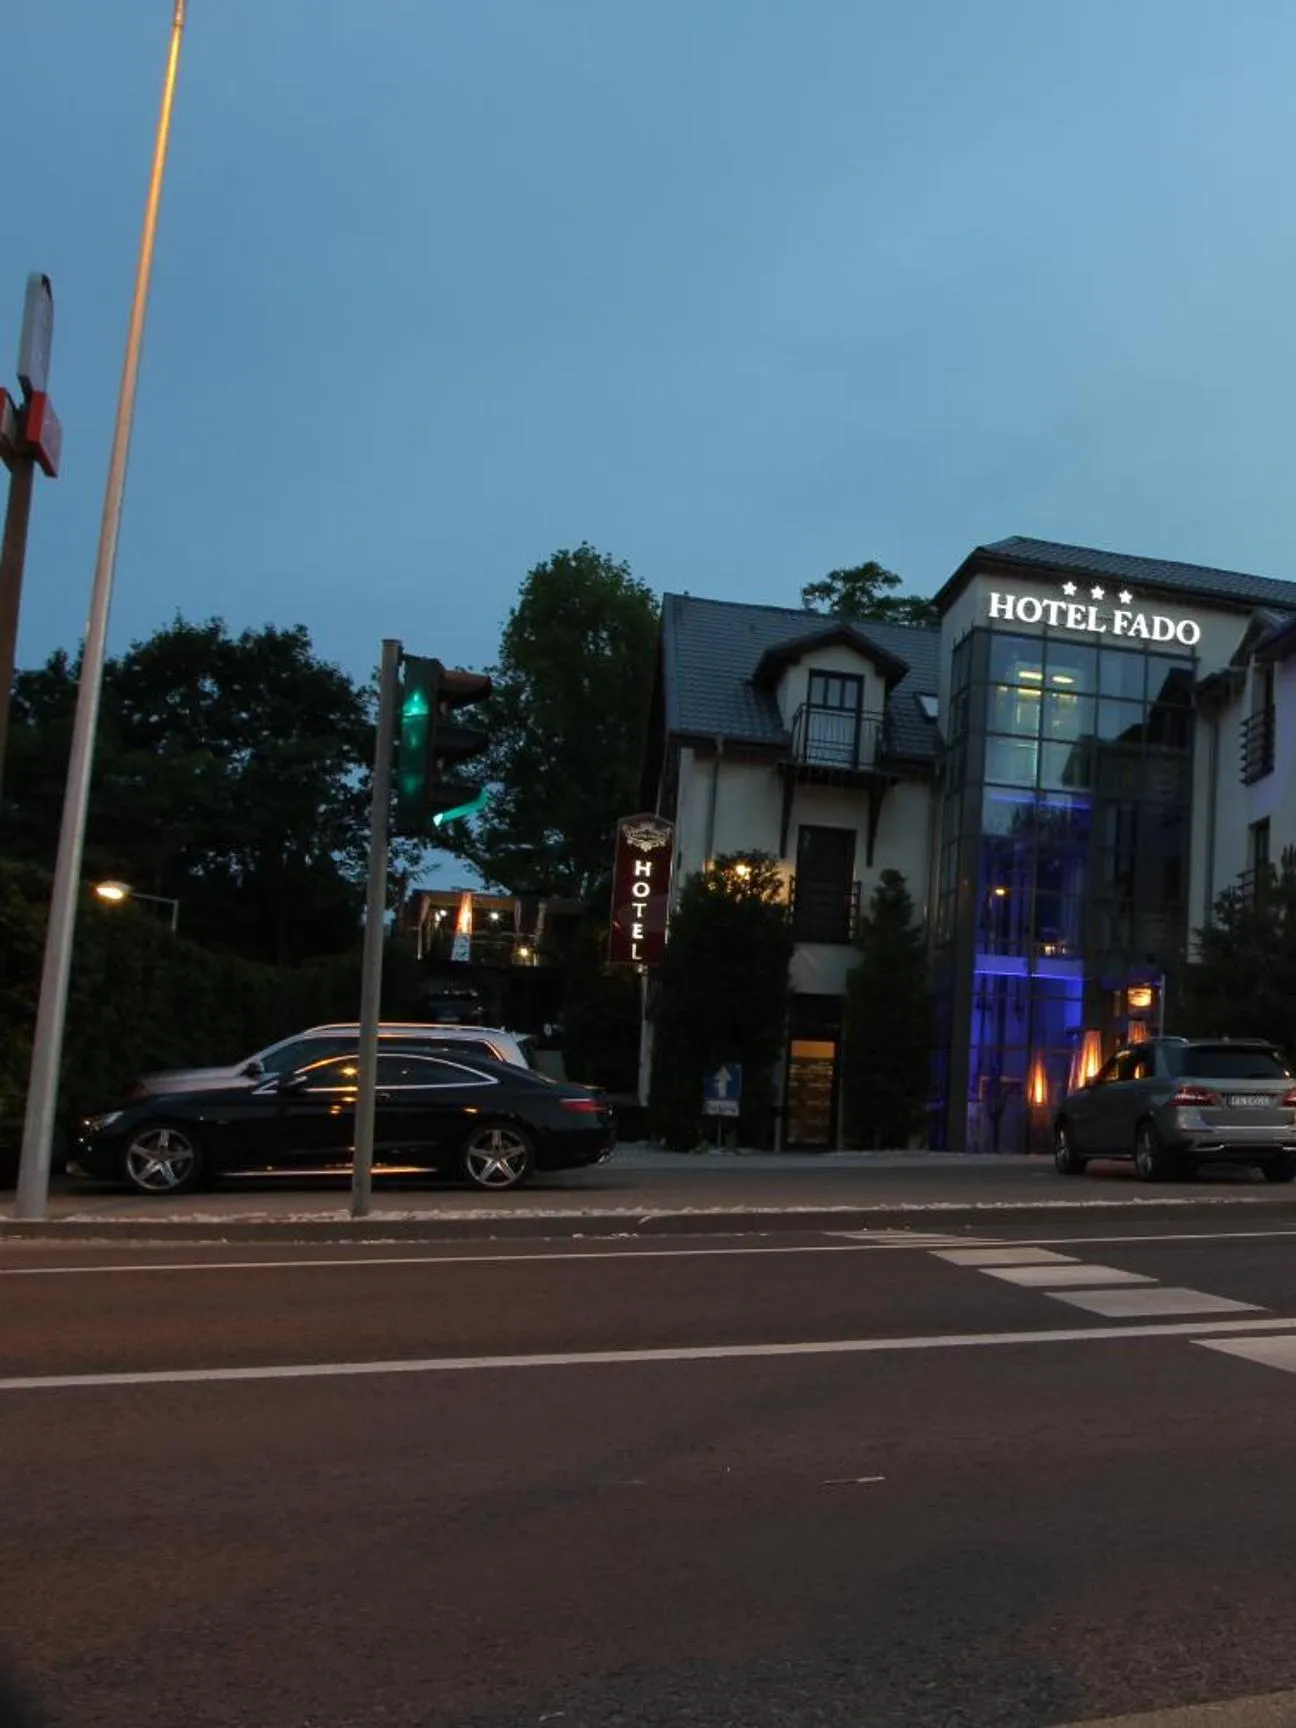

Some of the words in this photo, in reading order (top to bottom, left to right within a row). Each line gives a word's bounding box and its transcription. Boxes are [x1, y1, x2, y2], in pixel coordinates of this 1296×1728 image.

[988, 592, 1107, 633] HOTEL
[1112, 609, 1202, 646] FADO
[631, 859, 652, 961] HOTEL
